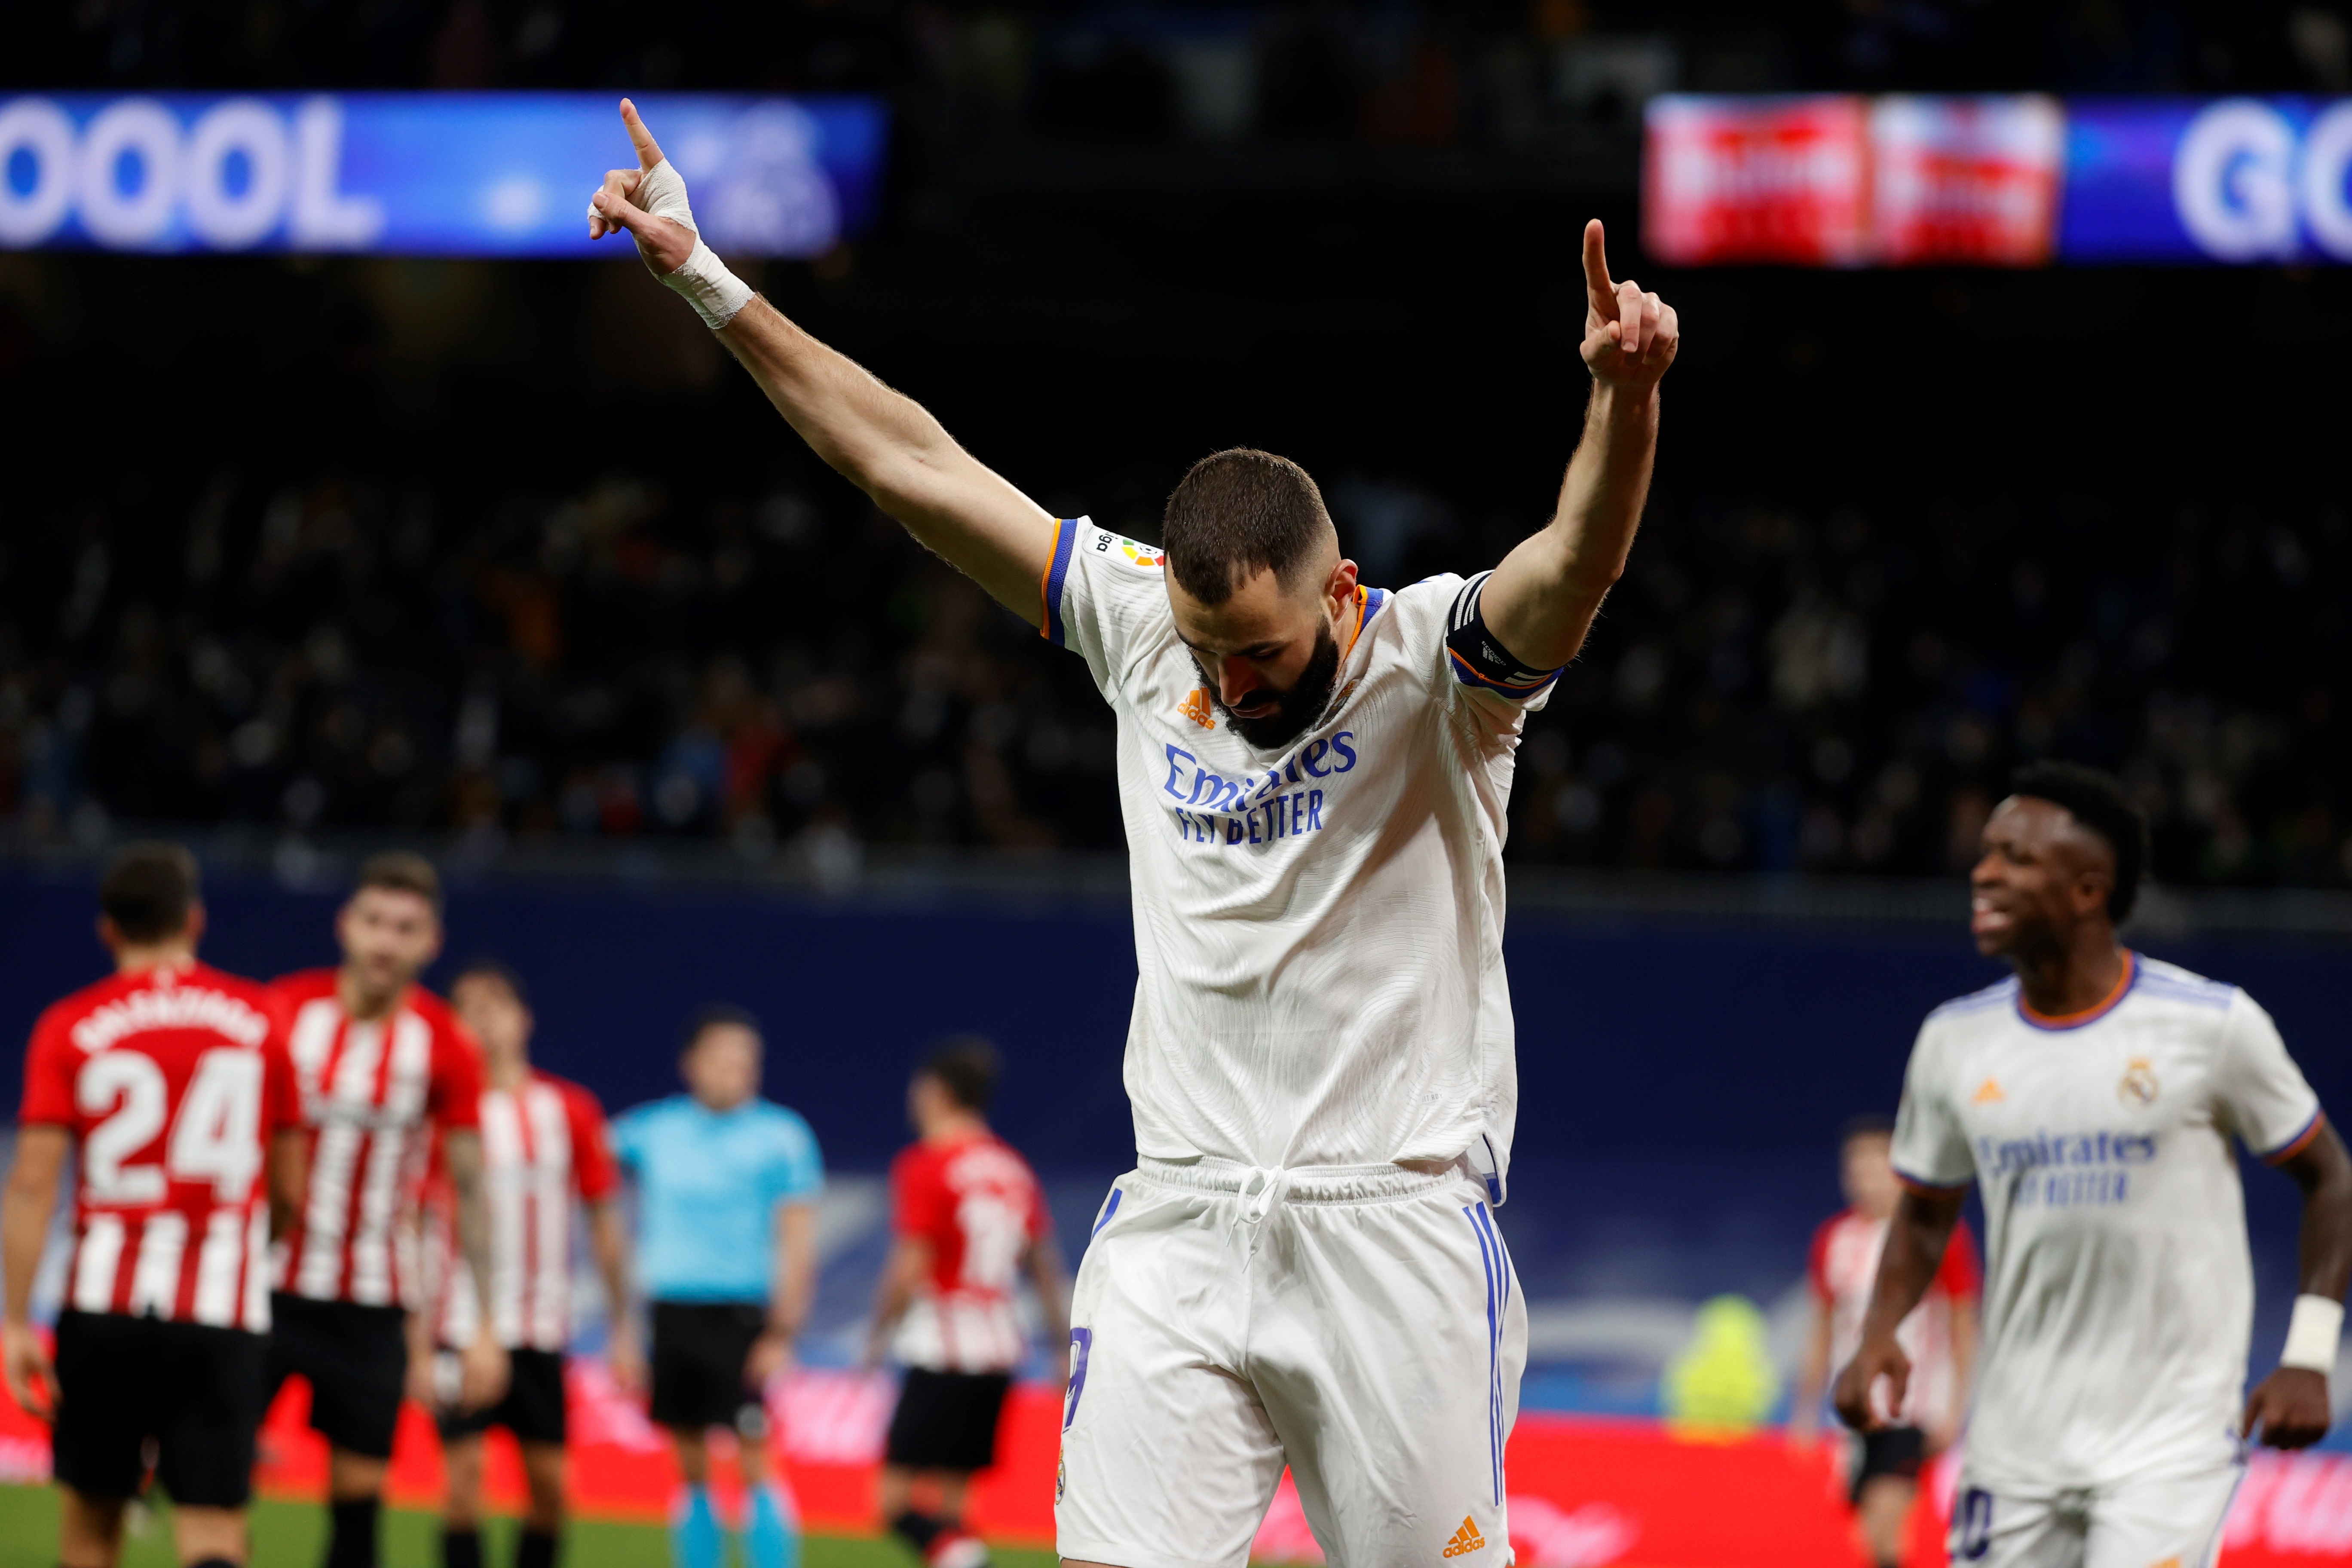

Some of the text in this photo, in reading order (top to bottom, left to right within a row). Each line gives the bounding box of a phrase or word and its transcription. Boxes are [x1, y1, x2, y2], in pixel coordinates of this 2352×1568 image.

[1096, 532, 1118, 552] iga
[1482, 640, 1506, 666] adidas
[1177, 702, 1216, 730] adidas
[1175, 789, 1324, 845] FLY BETTER
[77, 1047, 264, 1206] 24
[1443, 1537, 1485, 1558] adidas
